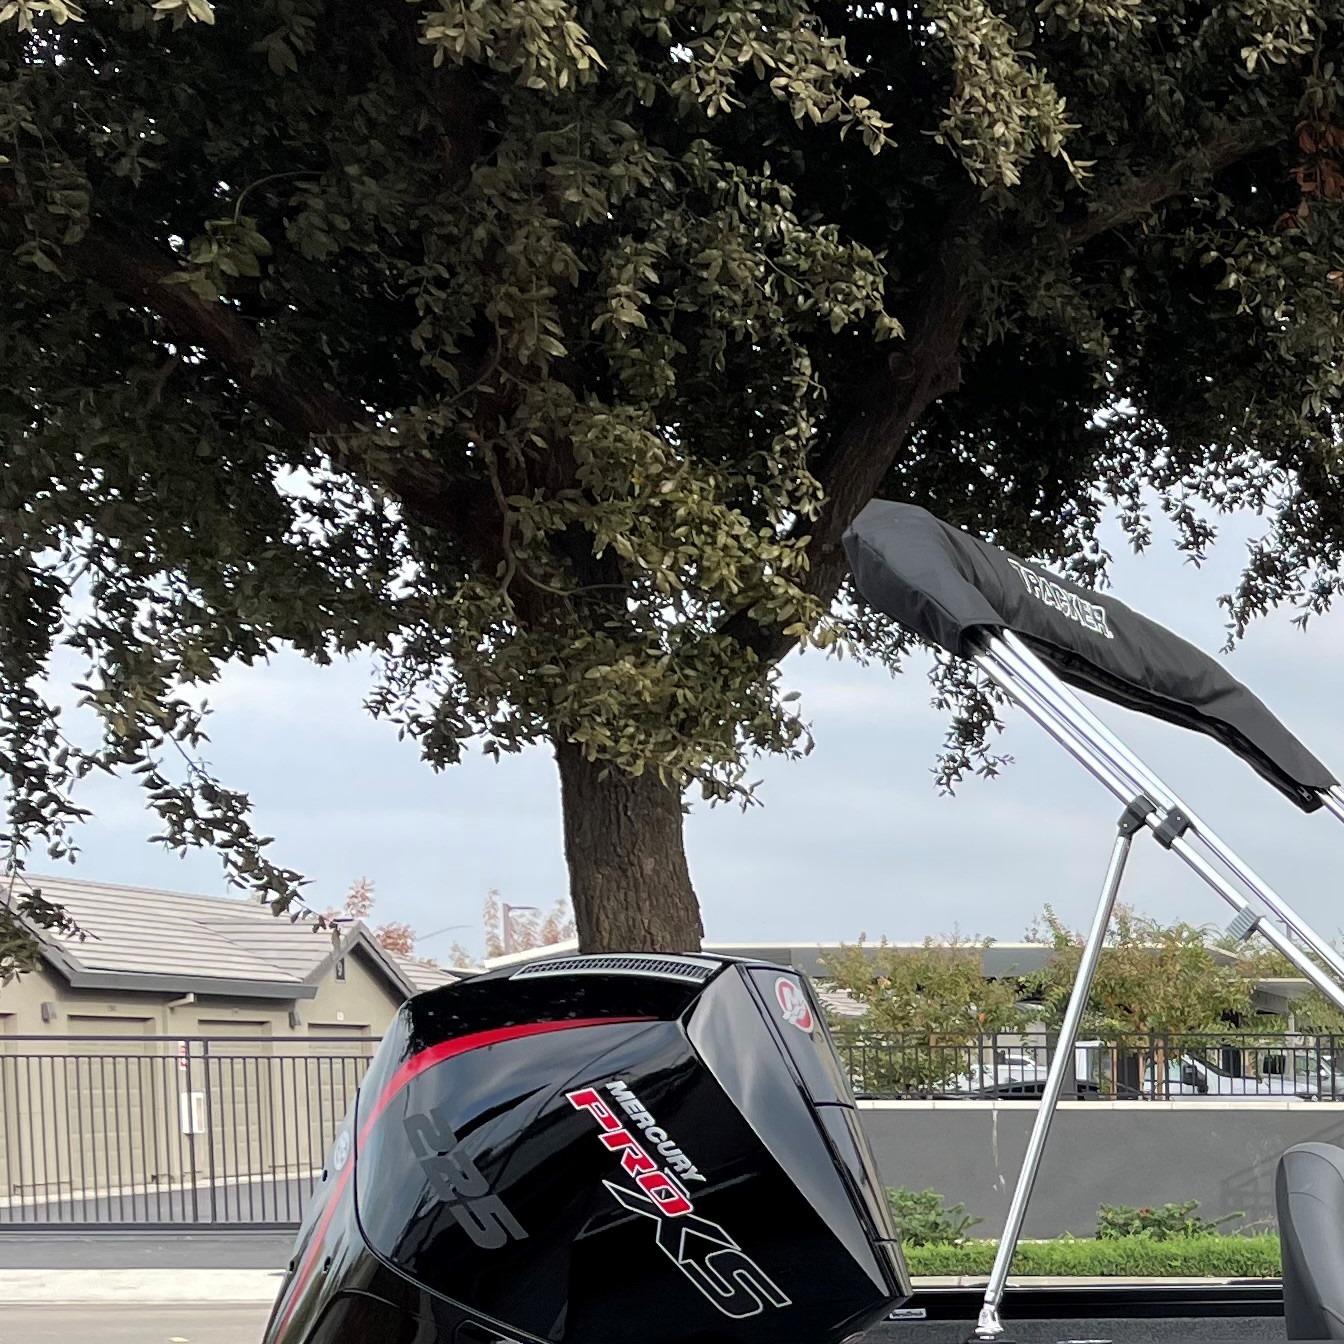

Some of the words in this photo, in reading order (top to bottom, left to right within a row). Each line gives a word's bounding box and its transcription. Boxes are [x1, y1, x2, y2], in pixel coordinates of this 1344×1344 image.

[1007, 558, 1114, 639] TRACKER
[402, 1106, 529, 1250] 225
[565, 1087, 694, 1217] PRO
[605, 1080, 707, 1182] MERCURY
